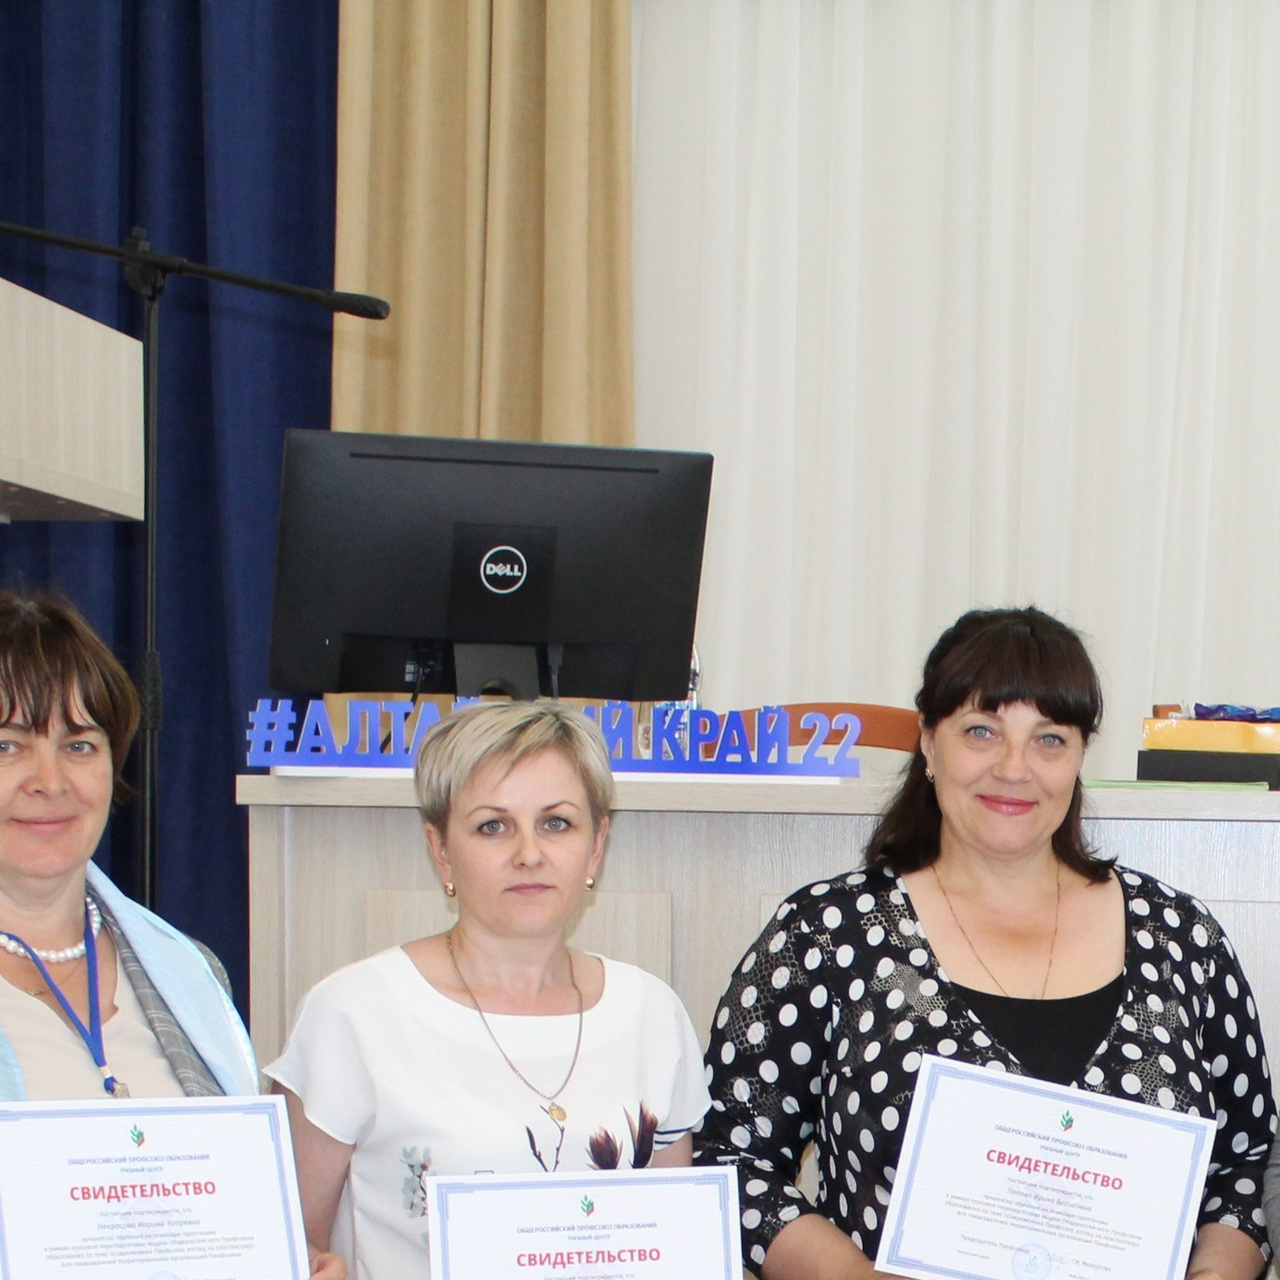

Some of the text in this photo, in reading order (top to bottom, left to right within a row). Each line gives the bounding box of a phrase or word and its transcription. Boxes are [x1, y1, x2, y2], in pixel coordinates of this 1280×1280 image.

[486, 563, 521, 576] DELL
[987, 1149, 1122, 1189] СВИДЕТЕЛЬСТВО
[70, 1181, 215, 1202] СВИДЕТЕЛЬСТВО
[517, 1248, 660, 1268] СВИДЕТЕЛЬСТВО
